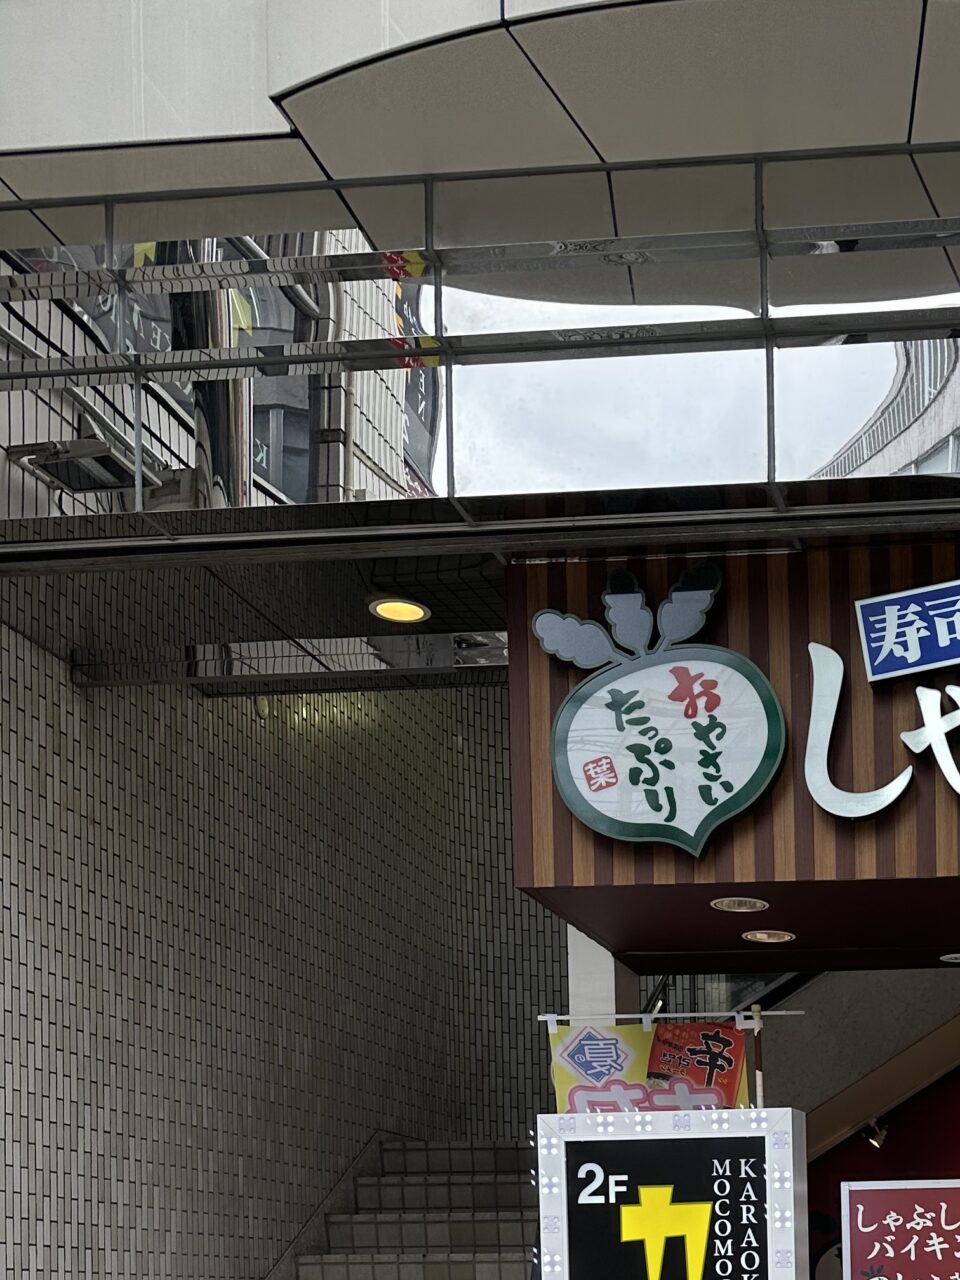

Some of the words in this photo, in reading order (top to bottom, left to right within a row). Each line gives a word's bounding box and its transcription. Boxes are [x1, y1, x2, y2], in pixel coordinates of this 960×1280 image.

[585, 757, 617, 791] 葉
[604, 688, 676, 823] たっぷり
[667, 666, 734, 806] おやさい
[577, 1162, 629, 1204] 2F
